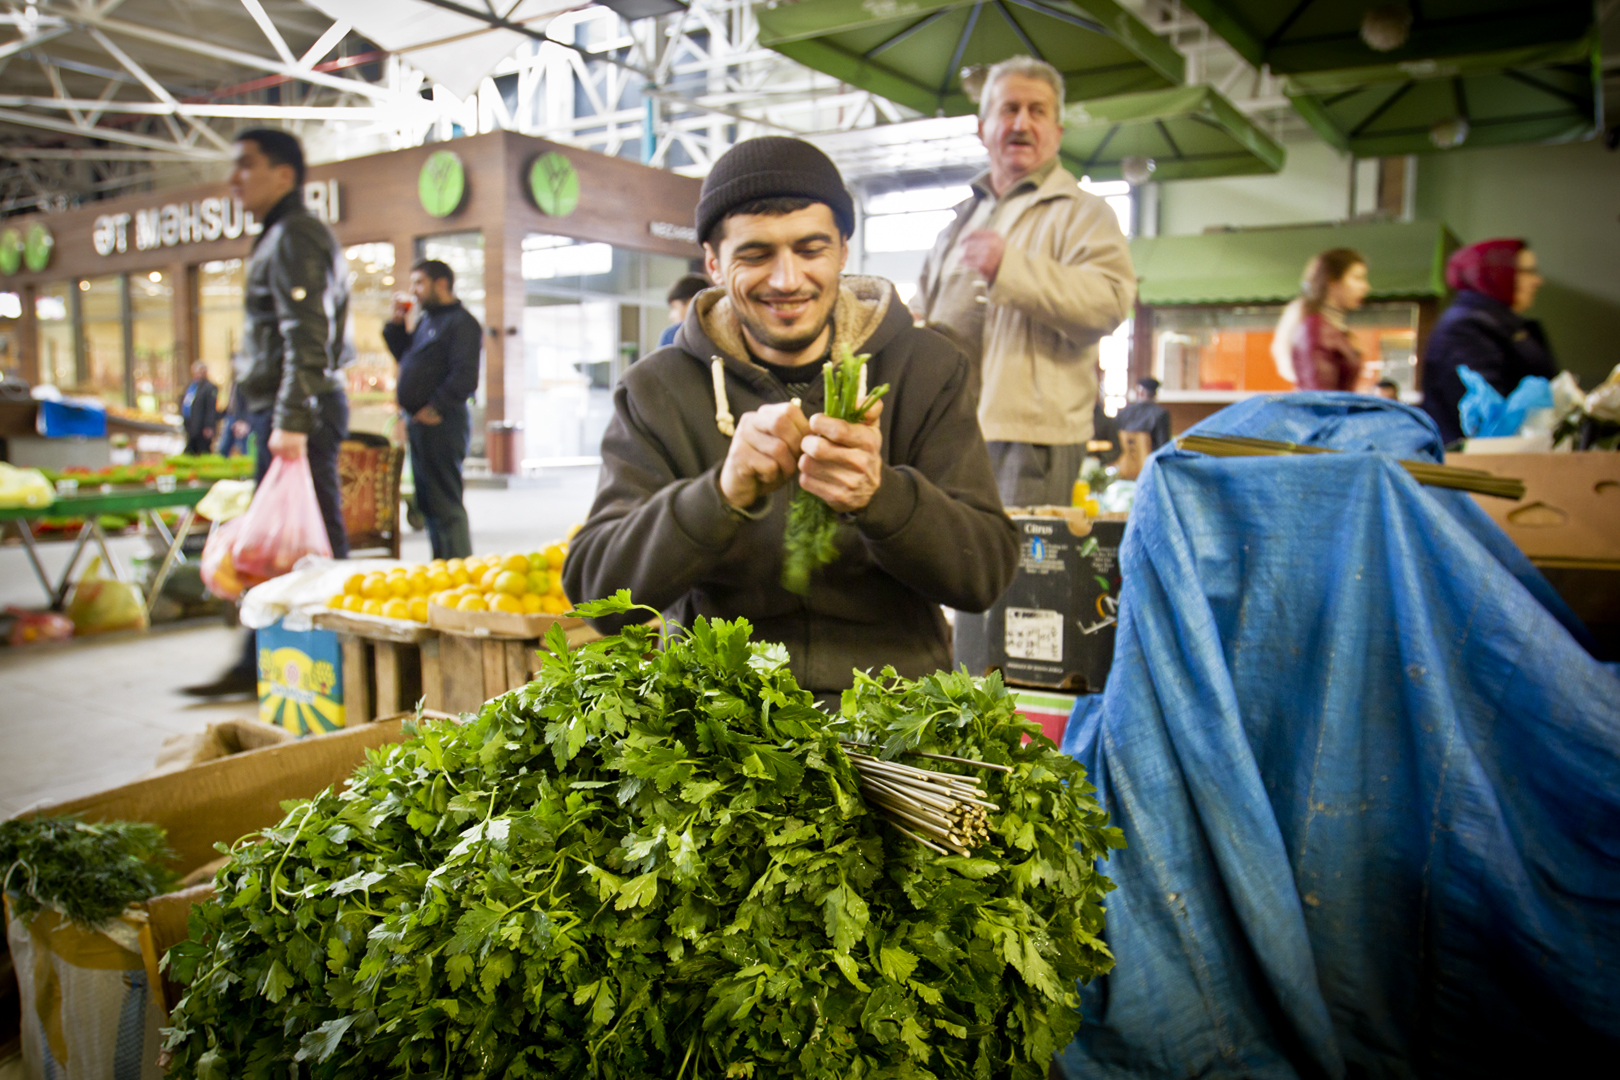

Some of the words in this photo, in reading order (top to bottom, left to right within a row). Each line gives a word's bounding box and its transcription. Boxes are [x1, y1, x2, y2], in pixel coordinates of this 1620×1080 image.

[93, 212, 131, 256] ƏT
[135, 178, 340, 251] MƏHSULRI
[1024, 523, 1053, 535] Citrus
